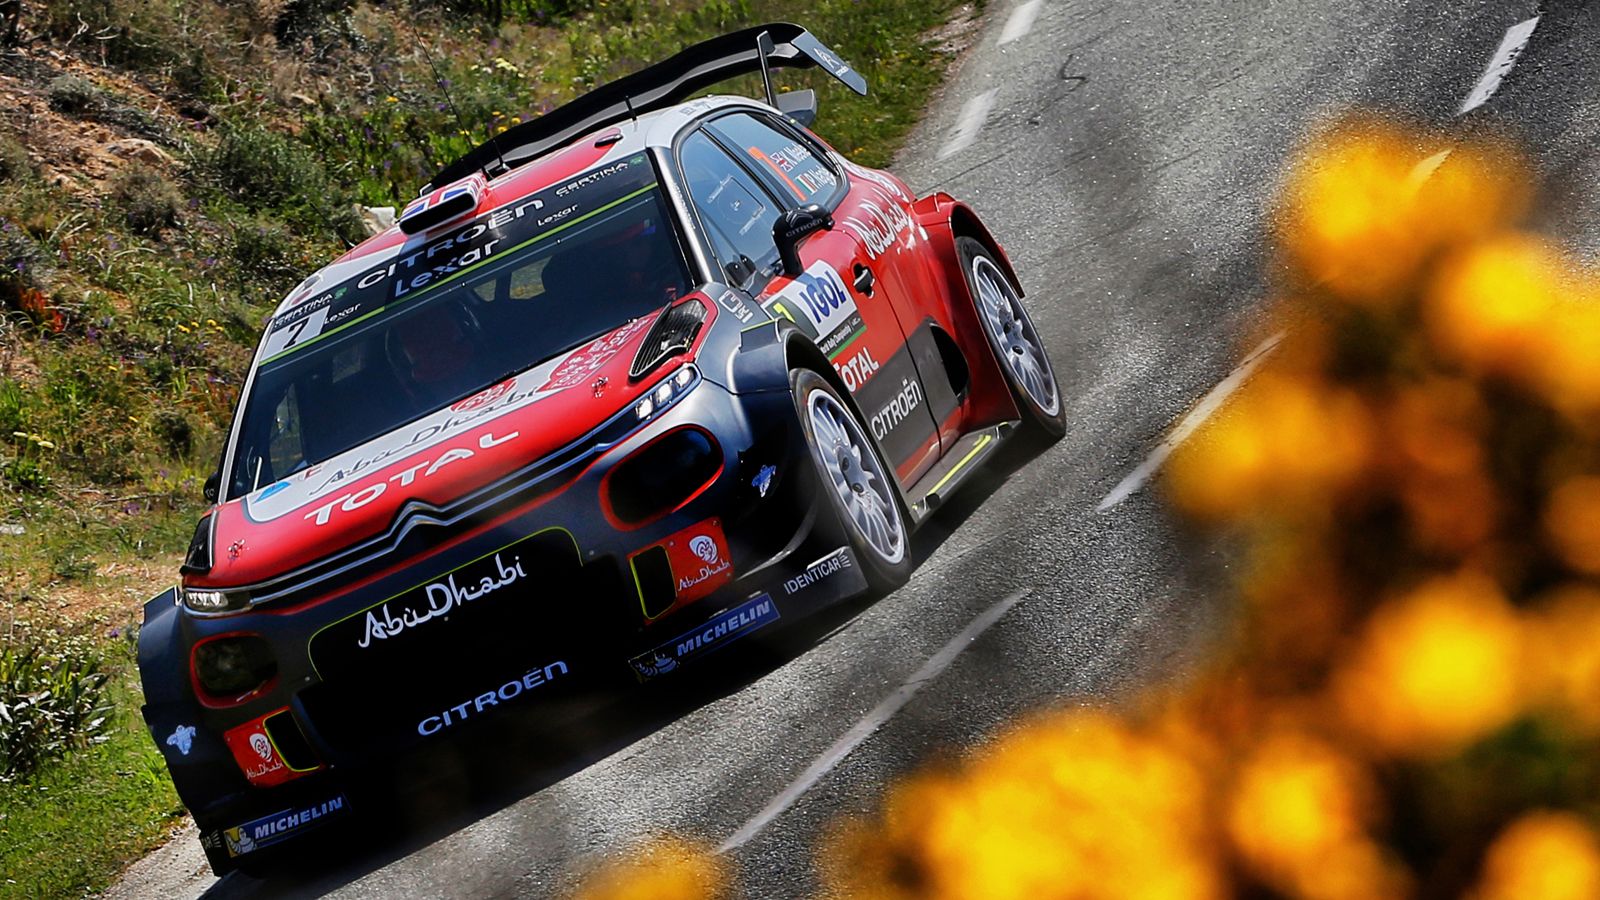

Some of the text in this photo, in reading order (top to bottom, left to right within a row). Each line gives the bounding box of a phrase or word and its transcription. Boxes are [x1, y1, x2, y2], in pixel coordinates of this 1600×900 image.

[537, 204, 579, 227] Lexar
[394, 238, 501, 298] Lexar
[324, 303, 361, 325] Lexar
[799, 270, 846, 324] IGOL
[282, 316, 311, 350] 7
[304, 431, 520, 527] TOTAL
[783, 556, 843, 596] IDENTICAR
[676, 600, 772, 658] MICHELIN
[254, 796, 343, 839] MICHELIN
